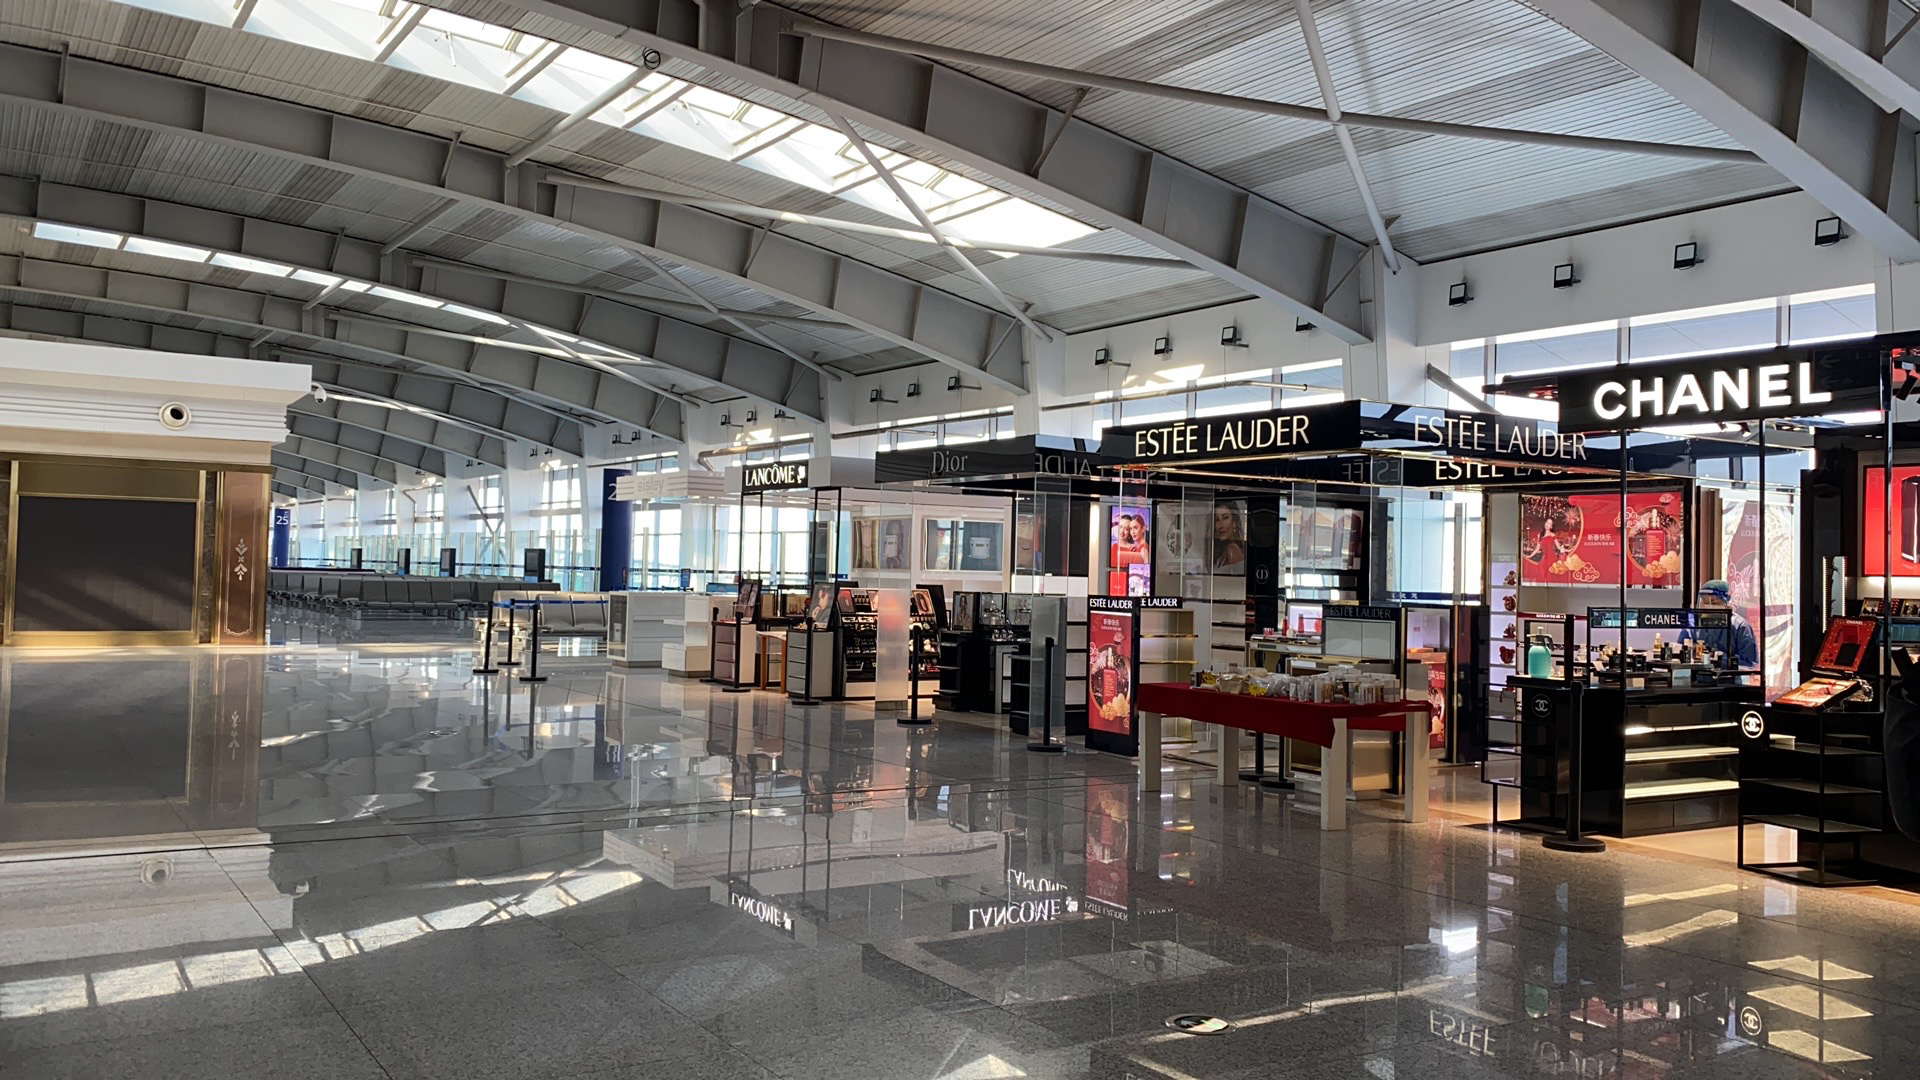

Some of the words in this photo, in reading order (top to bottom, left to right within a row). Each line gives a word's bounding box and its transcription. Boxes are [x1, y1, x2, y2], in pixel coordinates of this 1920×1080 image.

[1593, 362, 1832, 420] CHANEL
[1206, 415, 1309, 451] LAUDER
[1495, 423, 1587, 460] LAUDER
[931, 450, 968, 474] Dior
[745, 464, 795, 486] LANCÔME
[637, 477, 664, 494] sisley
[276, 515, 289, 525] 25
[1108, 600, 1133, 609] LAUDER
[1148, 598, 1178, 607] LAUDER
[1644, 614, 1681, 625] CHANEL
